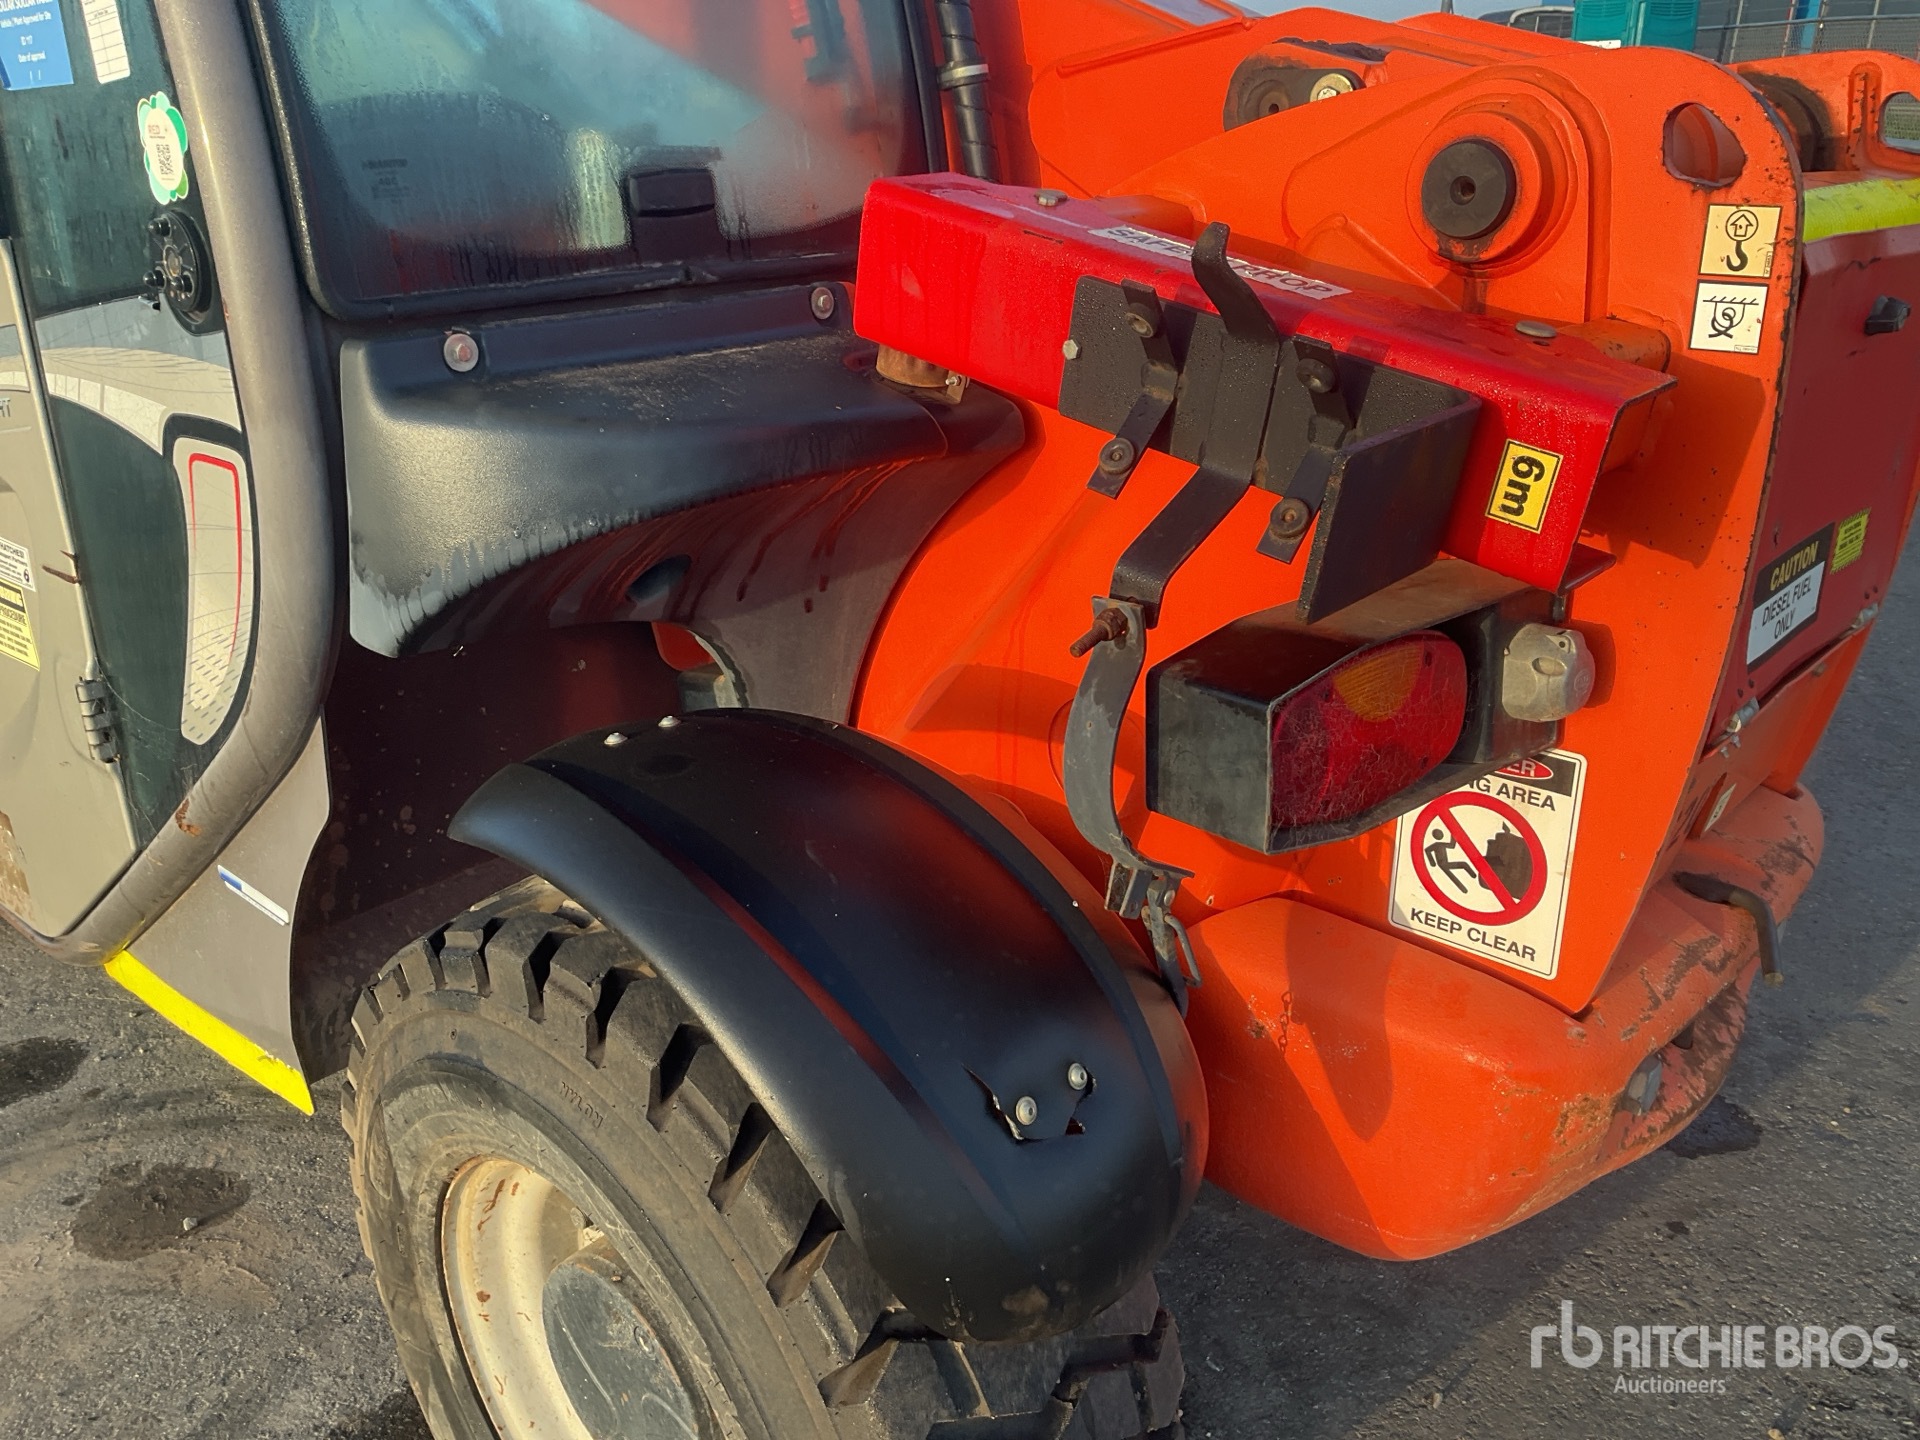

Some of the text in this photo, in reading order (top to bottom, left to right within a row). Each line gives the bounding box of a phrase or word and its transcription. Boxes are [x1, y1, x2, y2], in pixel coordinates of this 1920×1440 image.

[1107, 229, 1192, 256] SAFE
[1500, 455, 1546, 517] 6m
[1770, 541, 1818, 591] CAUTION
[1762, 576, 1812, 626] DIESEL FUEL
[1774, 609, 1796, 639] ONLY
[1495, 782, 1556, 812] AREA
[1410, 907, 1537, 963] KEEP CLEAR
